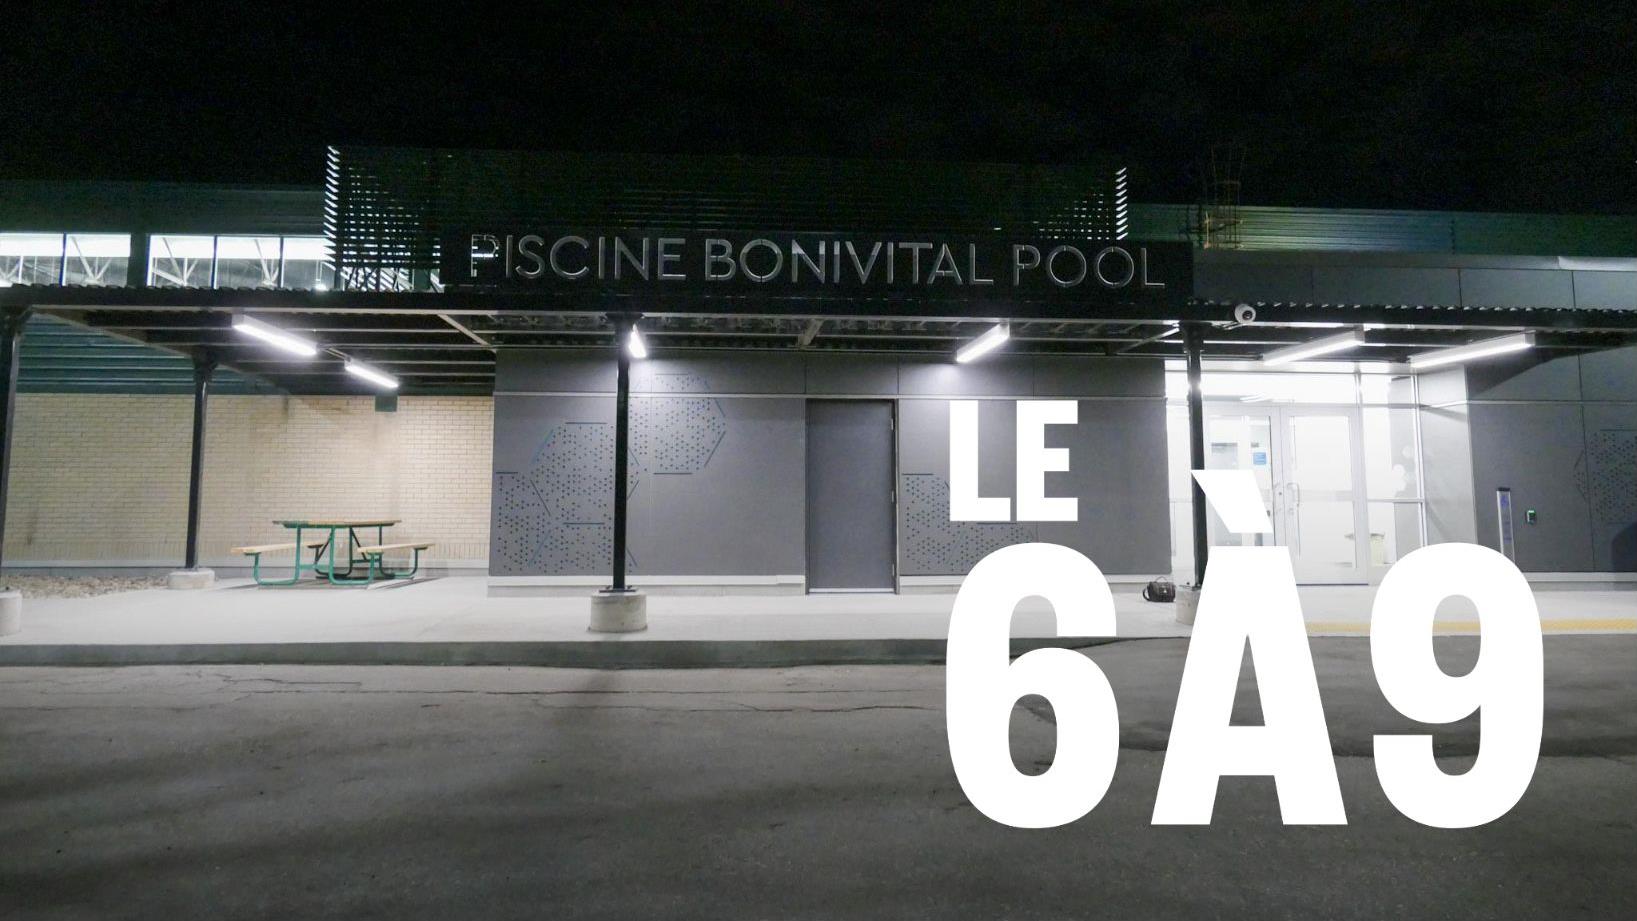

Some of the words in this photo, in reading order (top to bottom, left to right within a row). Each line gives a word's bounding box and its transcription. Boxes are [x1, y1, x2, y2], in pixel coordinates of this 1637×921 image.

[470, 233, 687, 281] PISCINE
[704, 238, 994, 285] BONIVITAL
[1012, 244, 1165, 288] POOL
